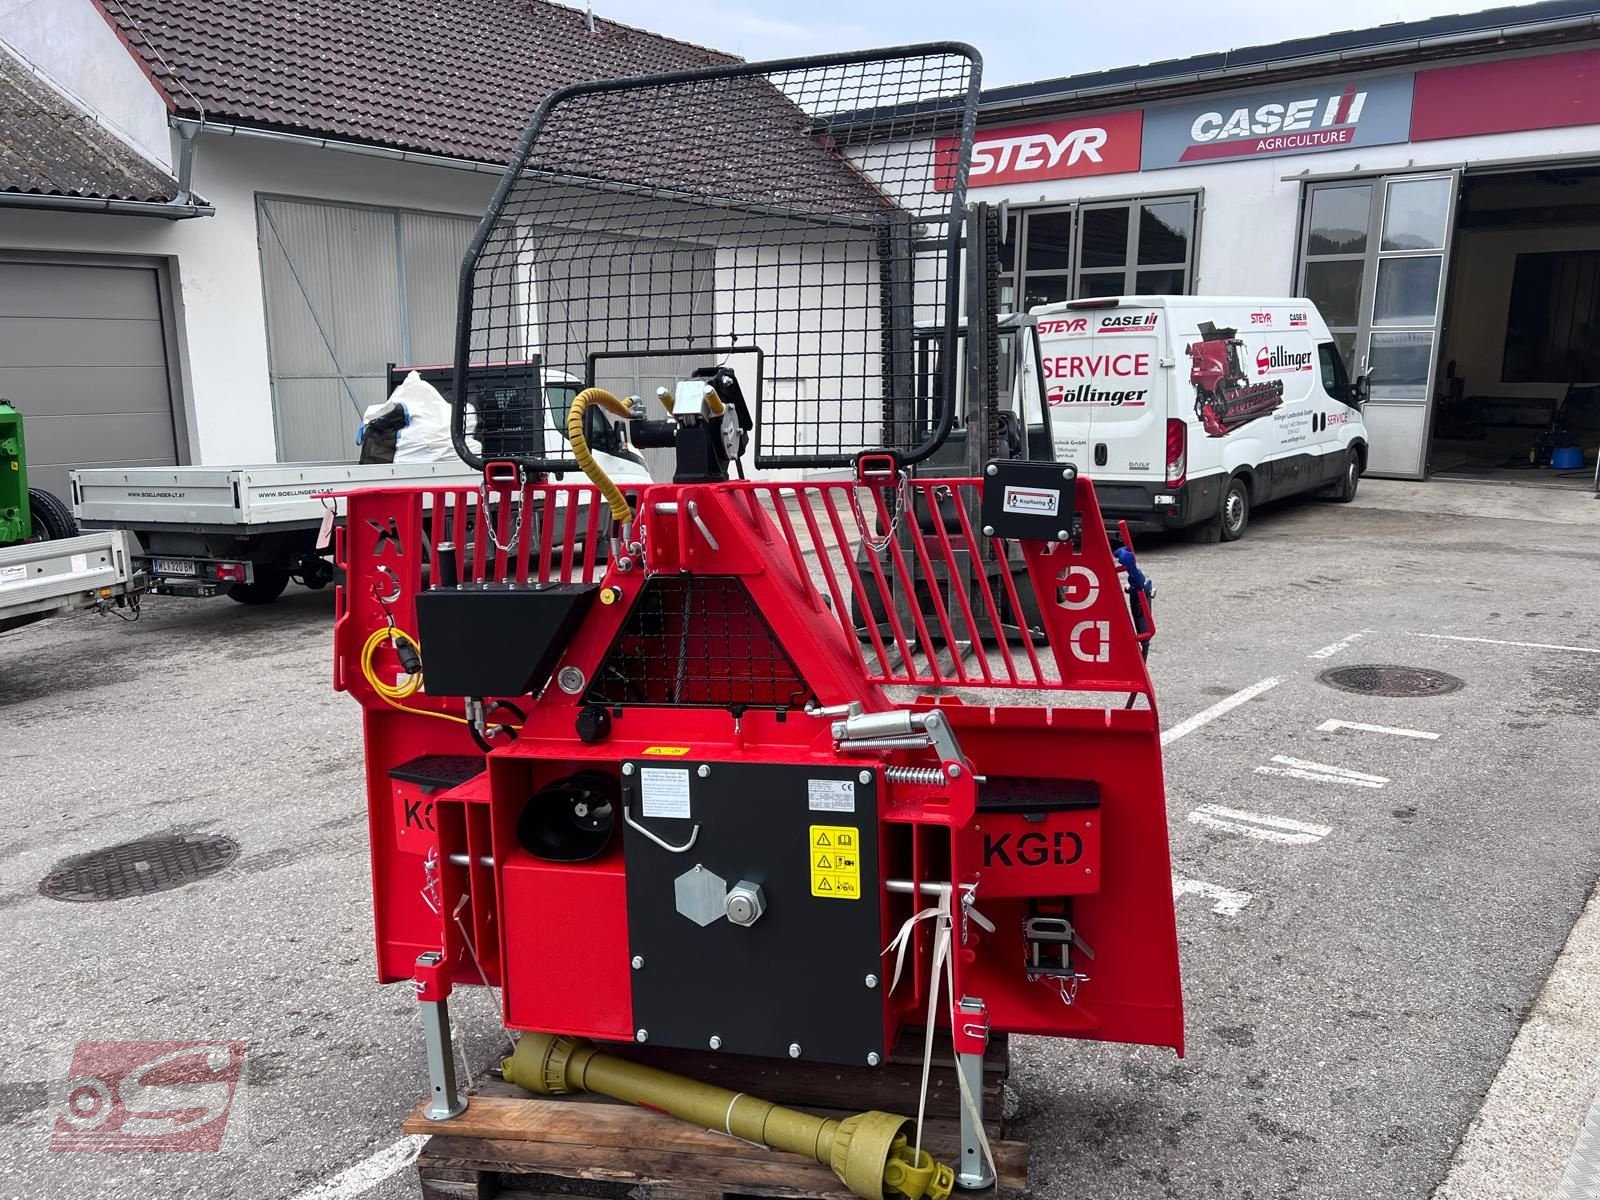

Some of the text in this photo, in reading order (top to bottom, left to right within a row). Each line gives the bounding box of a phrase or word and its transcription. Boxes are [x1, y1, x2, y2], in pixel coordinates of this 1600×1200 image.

[1191, 99, 1318, 142] CASE
[969, 128, 1107, 176] STEYR
[1256, 131, 1347, 151] AGRICULTURE
[1038, 318, 1088, 334] STEYR
[1101, 316, 1143, 327] CASE
[1251, 313, 1272, 323] STEYR
[1042, 354, 1149, 378] SERVICE
[1256, 346, 1312, 375] Söllinger
[1047, 384, 1148, 407] Söllinger
[1327, 412, 1348, 425] SERVICE
[983, 831, 1083, 868] KGD
